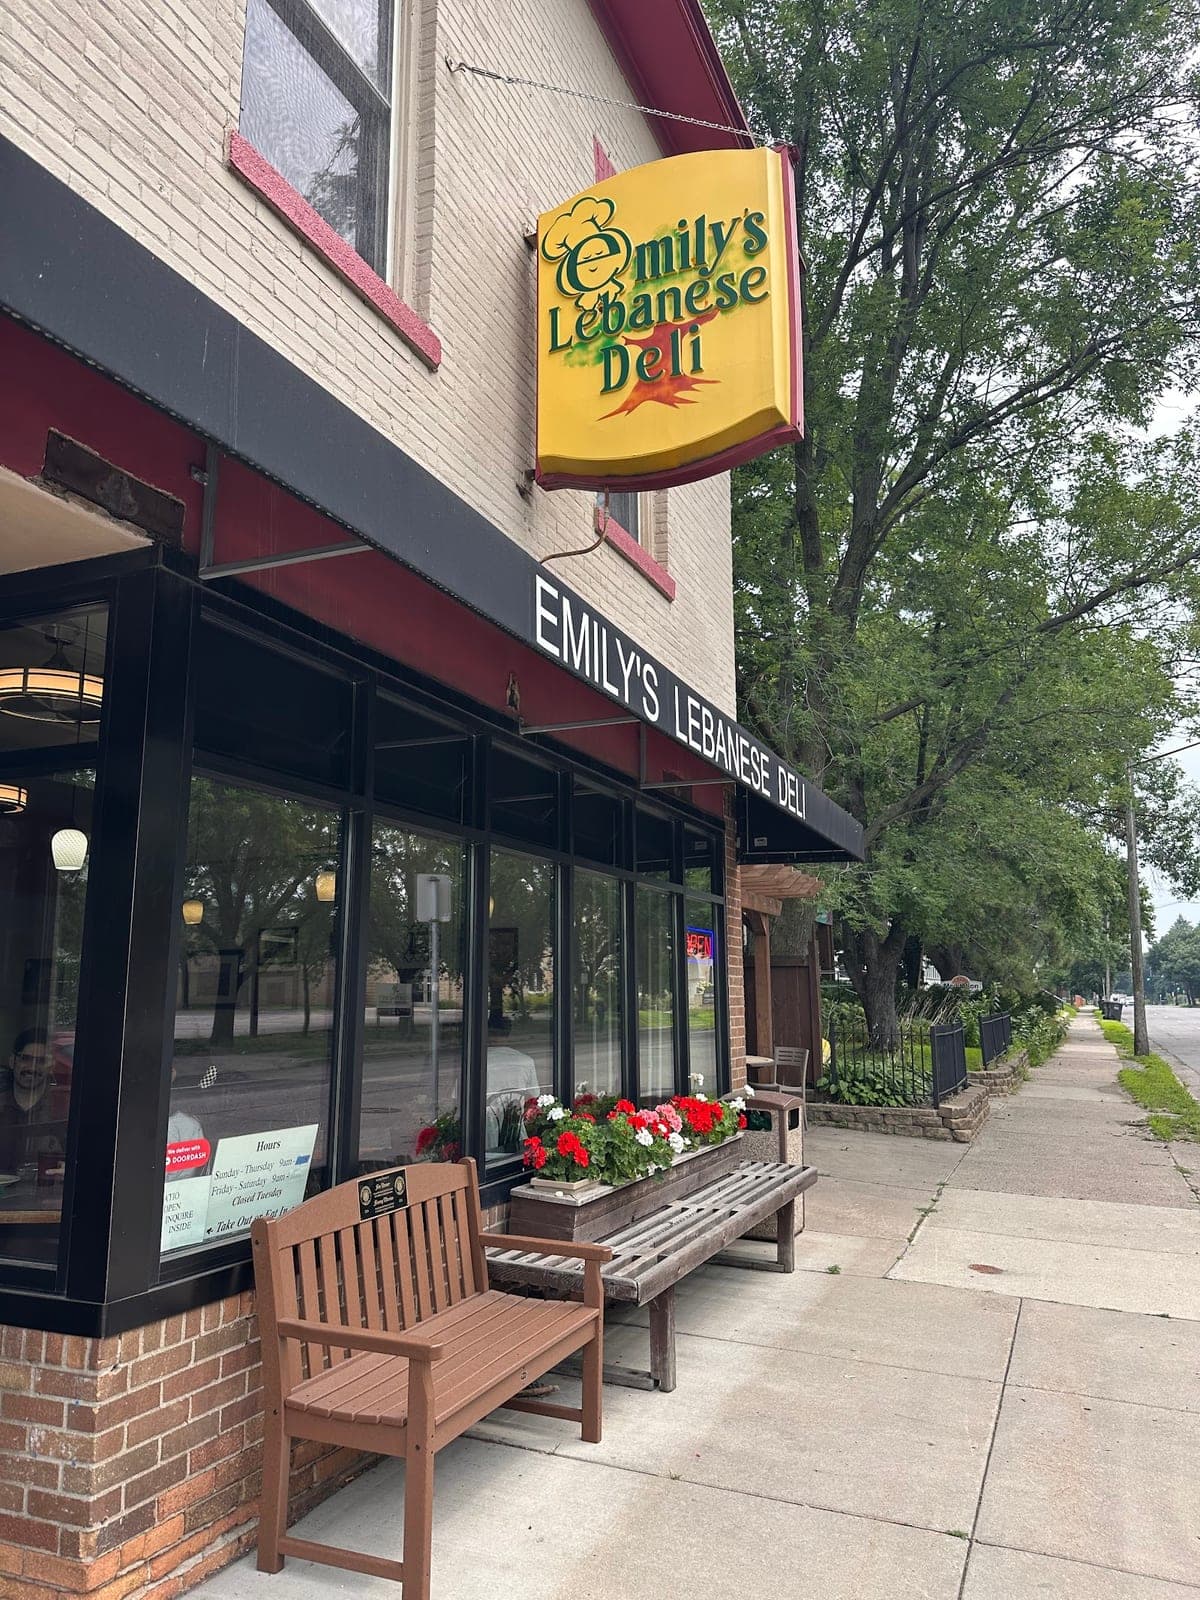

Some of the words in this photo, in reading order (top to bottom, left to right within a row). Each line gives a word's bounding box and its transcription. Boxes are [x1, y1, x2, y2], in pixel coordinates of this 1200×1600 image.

[549, 265, 769, 354] Lebanese
[600, 323, 704, 394] Deli
[535, 574, 659, 722] EMILY'S
[674, 685, 771, 798] LEBANESE
[777, 765, 806, 820] DELI
[256, 1141, 281, 1152] Hours
[172, 1152, 206, 1163] DOORDASH
[214, 1168, 239, 1180] Sunday
[245, 1161, 274, 1174] Thursday
[211, 1184, 233, 1196] Friday
[239, 1177, 266, 1190] Saturday
[232, 1192, 256, 1206] Closed
[257, 1188, 282, 1200] Tuesday
[168, 1221, 192, 1233] INSIDE
[217, 1219, 236, 1232] Take
